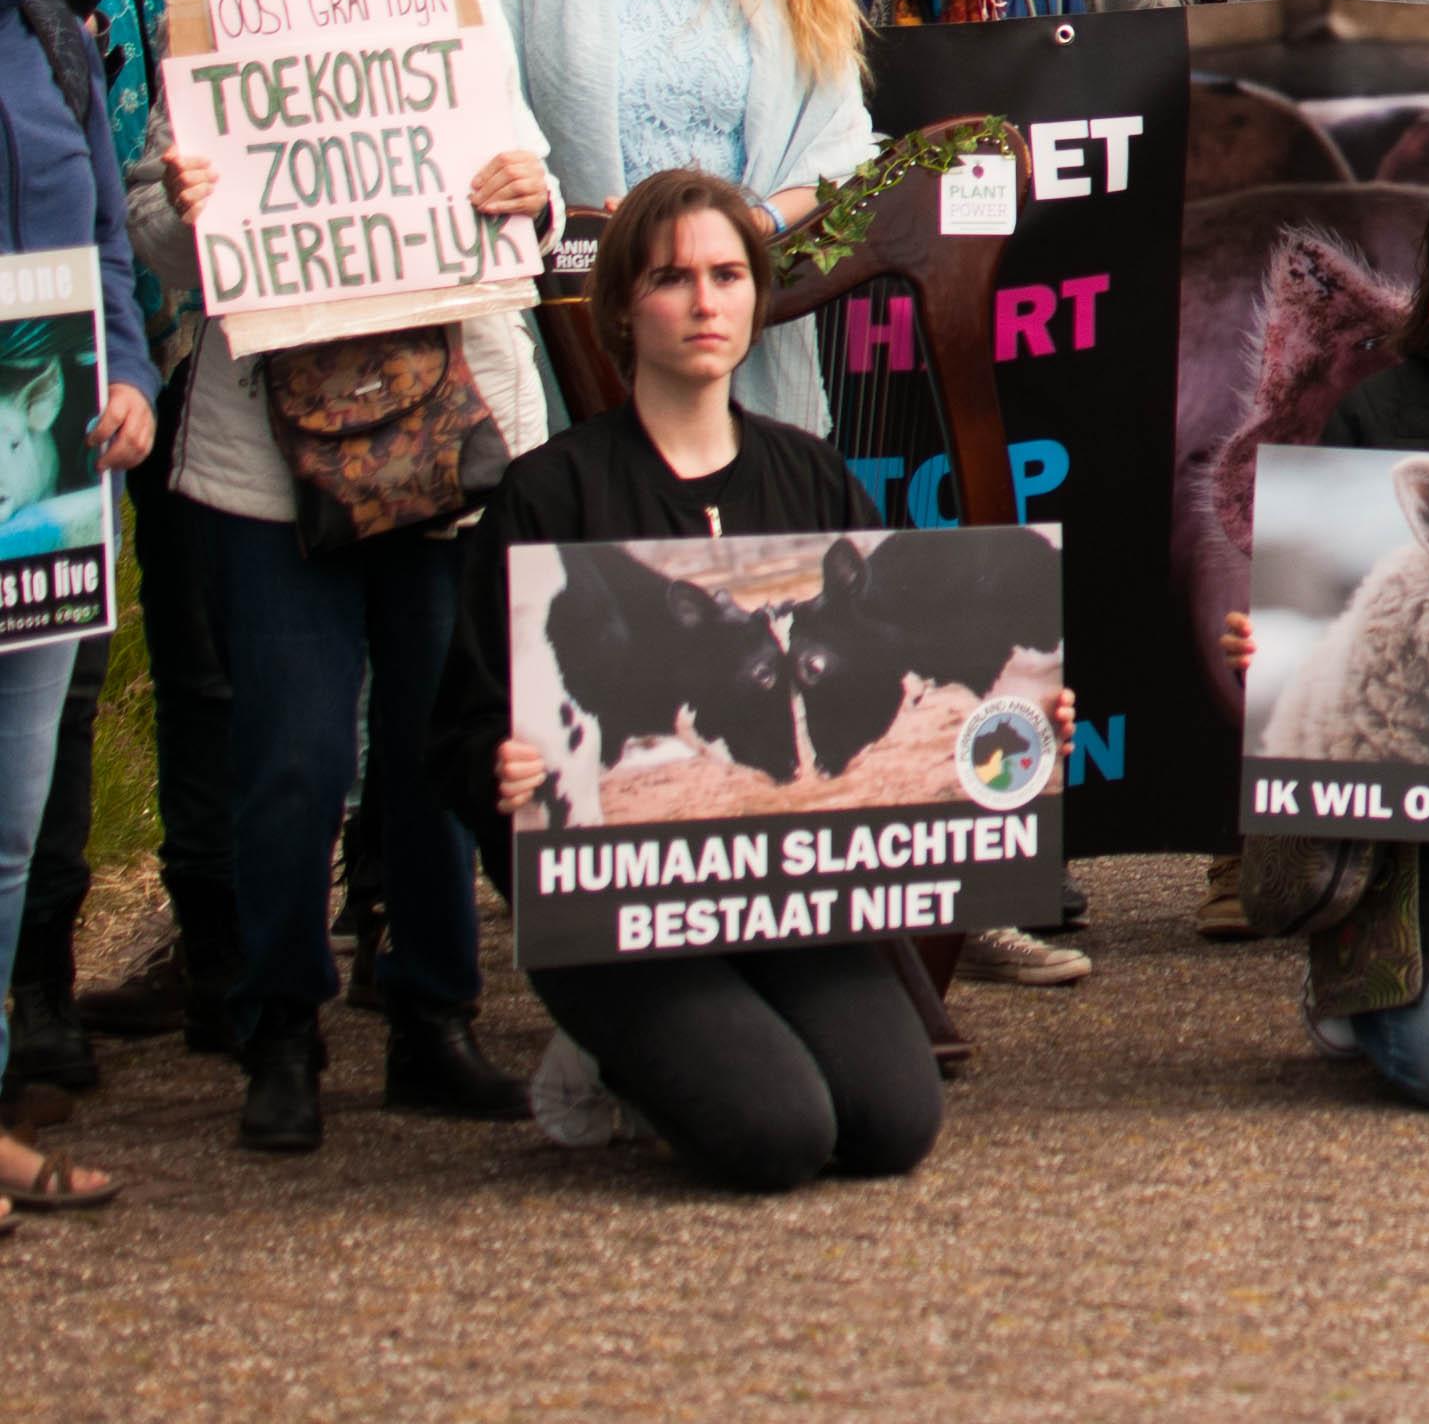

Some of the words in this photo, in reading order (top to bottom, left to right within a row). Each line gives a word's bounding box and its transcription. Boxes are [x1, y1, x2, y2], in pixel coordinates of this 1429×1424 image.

[247, 126, 445, 215] ZONDER
[950, 185, 1006, 198] PLANT
[951, 203, 1007, 216] POWER
[846, 274, 1111, 372] HRT
[22, 568, 47, 604] to
[54, 558, 99, 599] live
[1254, 778, 1300, 816] IK
[1312, 781, 1392, 818] WIL
[539, 833, 768, 895] HUMAAN
[782, 814, 1038, 876] SLACHTEN
[617, 890, 838, 952] BESTAAT
[851, 880, 961, 930] NIET
